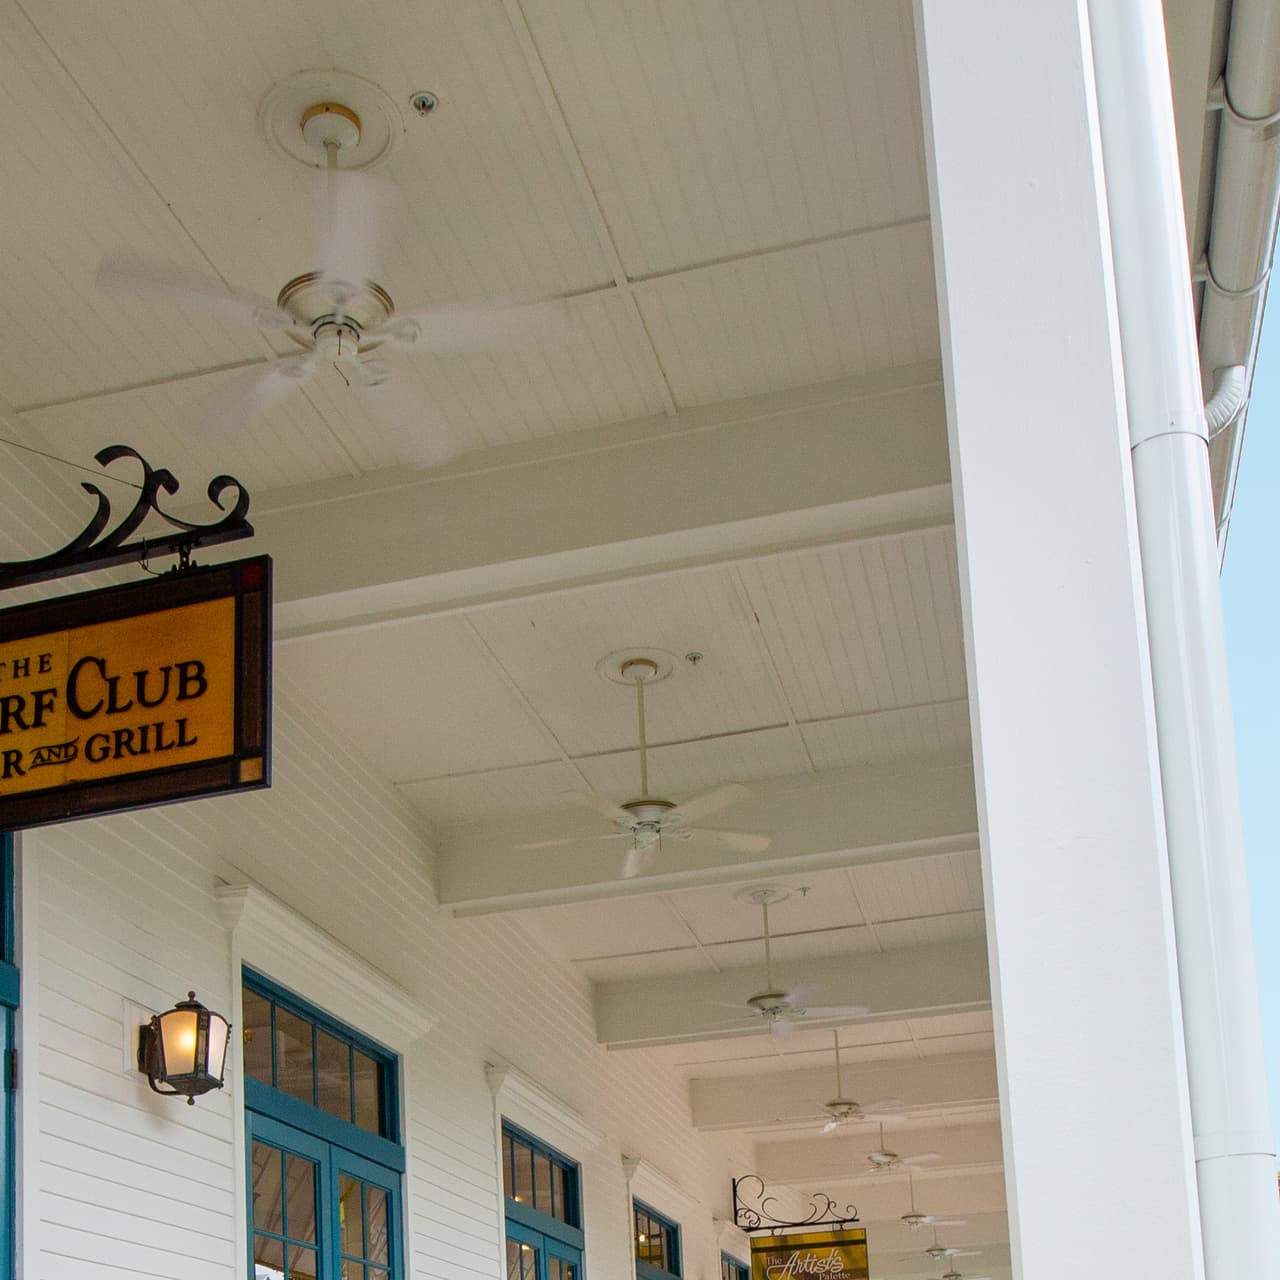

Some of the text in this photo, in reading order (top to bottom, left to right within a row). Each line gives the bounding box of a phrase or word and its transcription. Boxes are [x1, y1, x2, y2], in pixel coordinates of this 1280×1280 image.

[66, 655, 208, 720] CLUB
[29, 738, 80, 768] AND
[85, 718, 198, 763] GRILL
[767, 1255, 783, 1265] The
[819, 1271, 851, 1280] Palette
